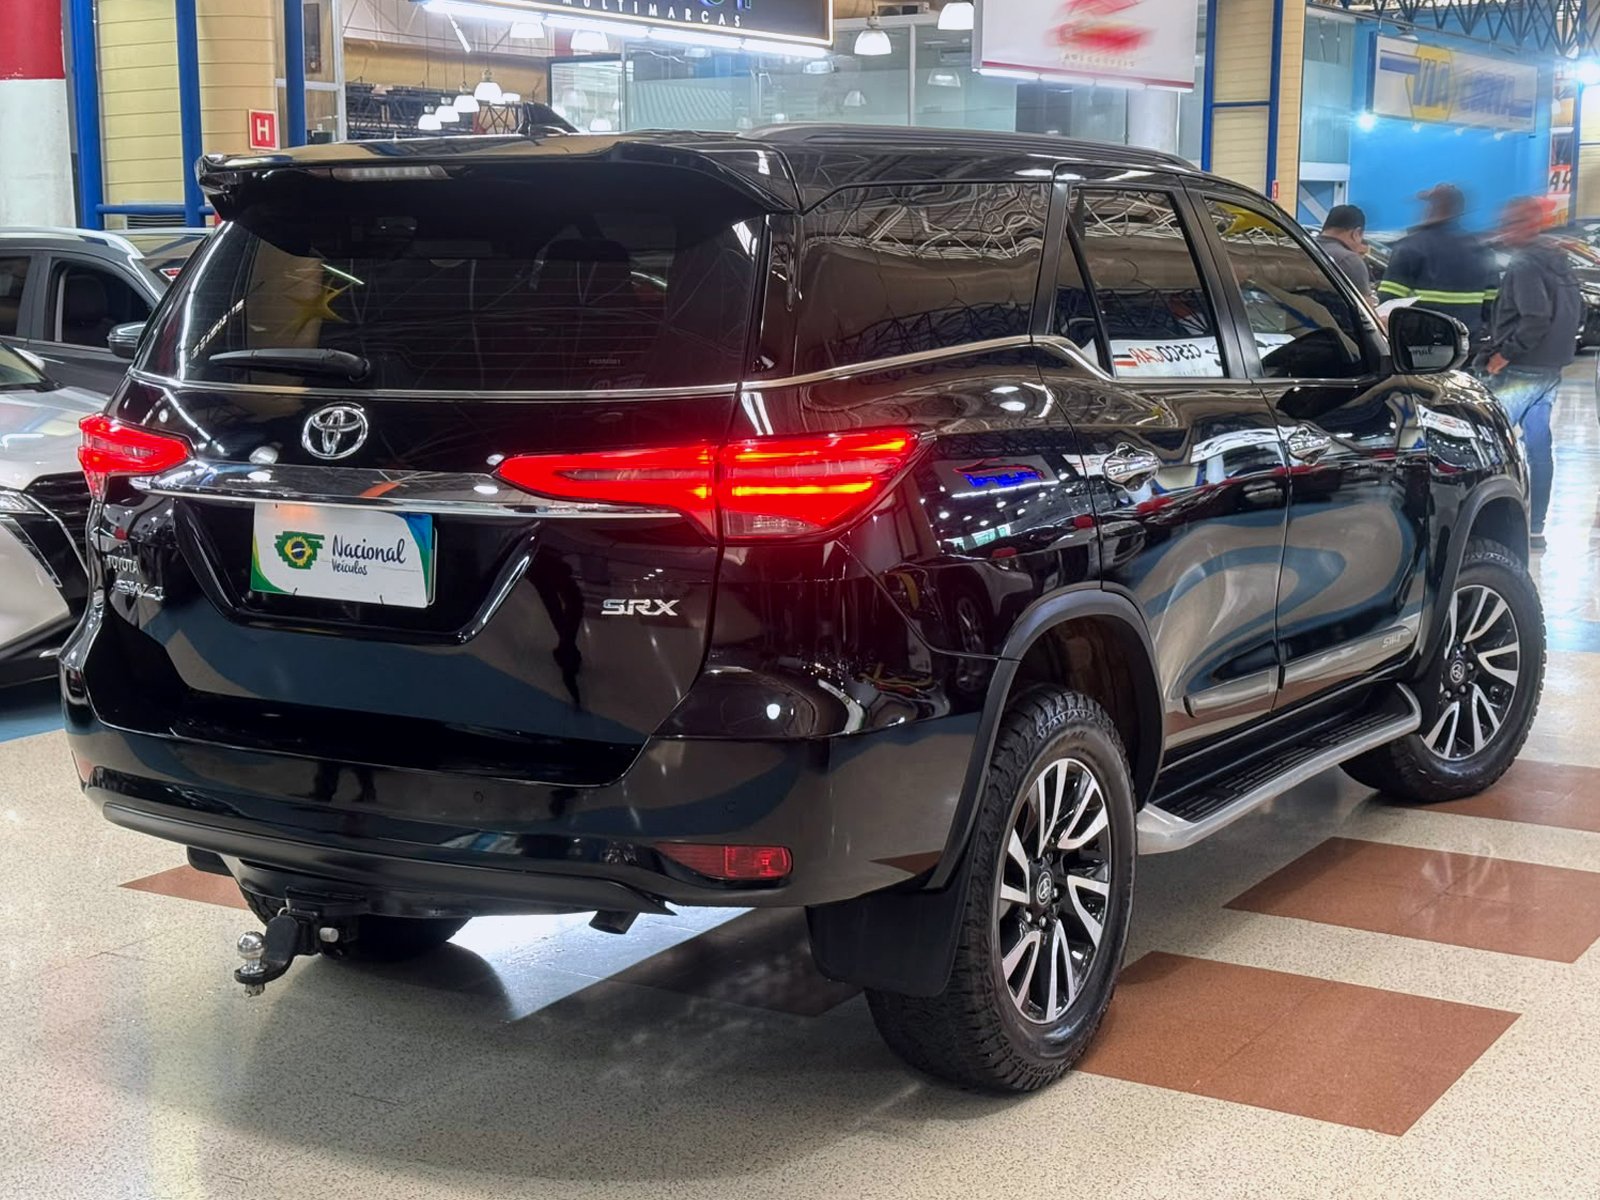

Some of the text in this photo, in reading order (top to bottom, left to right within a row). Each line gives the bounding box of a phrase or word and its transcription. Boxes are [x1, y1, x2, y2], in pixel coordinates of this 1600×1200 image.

[256, 118, 270, 141] H
[332, 534, 406, 564] Nacional
[601, 599, 680, 616] SRX
